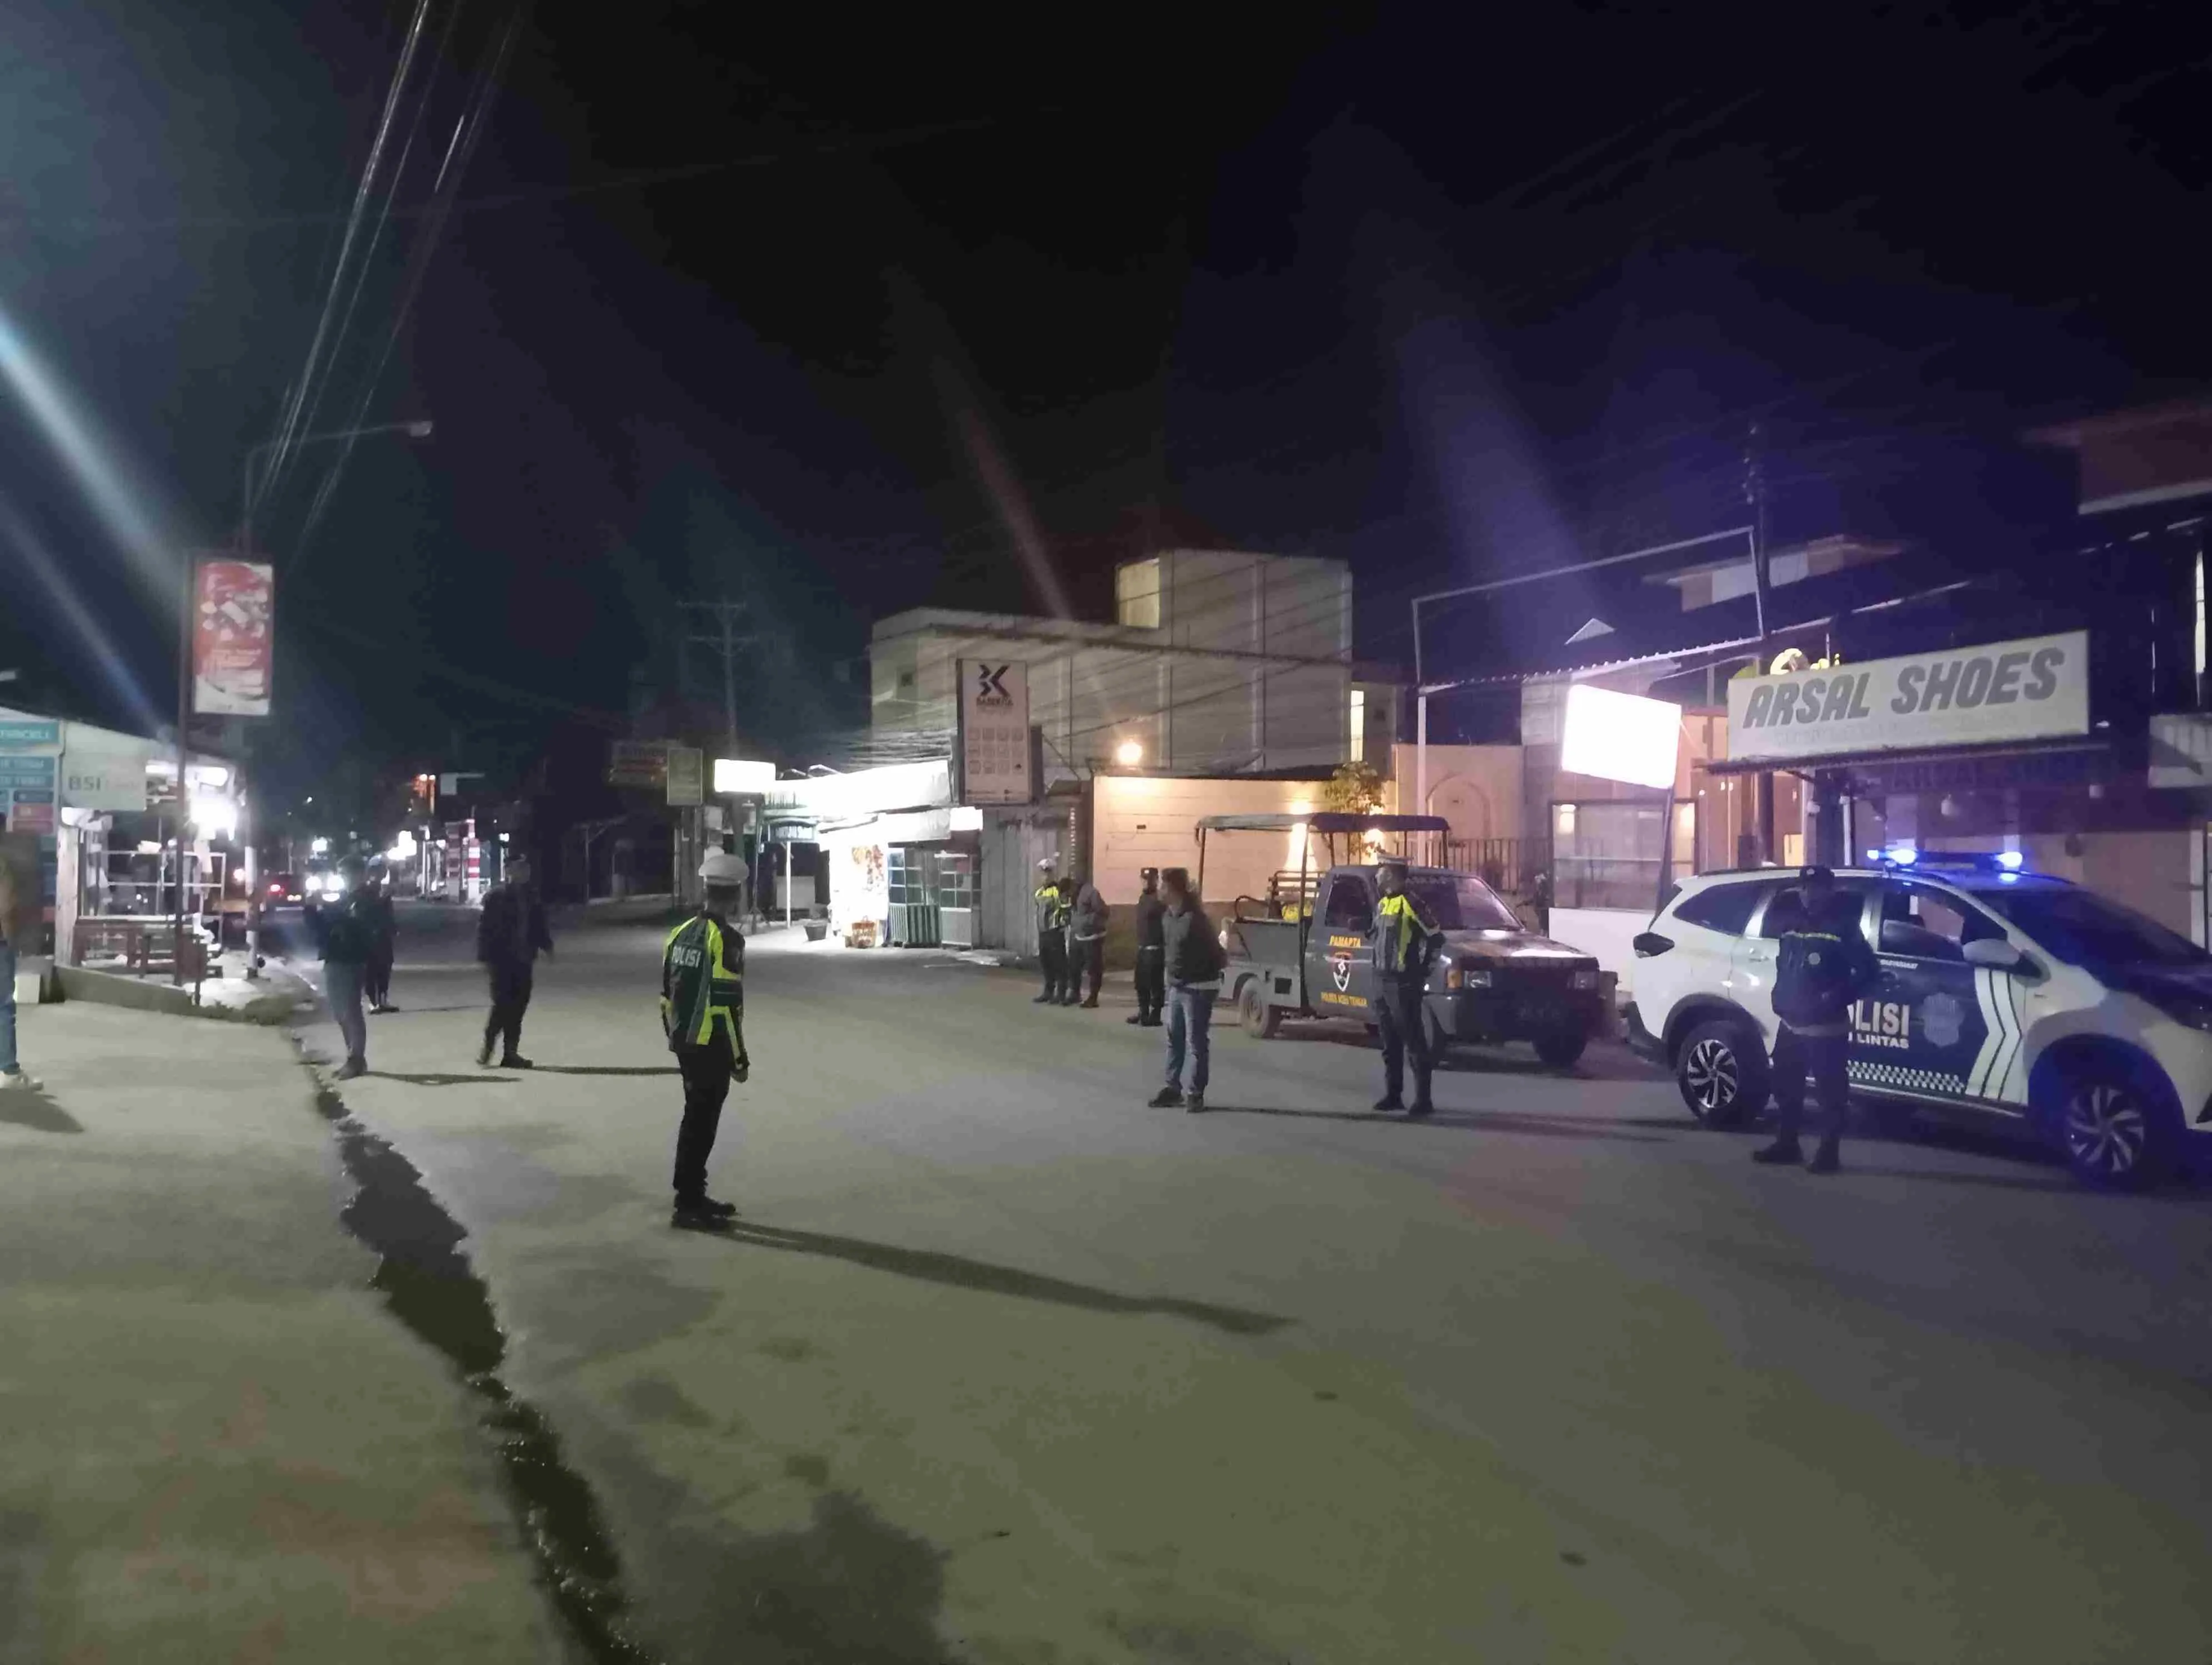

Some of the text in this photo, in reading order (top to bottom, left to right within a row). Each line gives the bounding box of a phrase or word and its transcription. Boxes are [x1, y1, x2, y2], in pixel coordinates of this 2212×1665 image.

[1742, 671, 1871, 729] ARSAL
[1890, 646, 2065, 715] SHOES
[69, 776, 101, 791] BSI
[672, 946, 701, 968] POLISI
[1857, 1033, 1909, 1049] LINTAS
